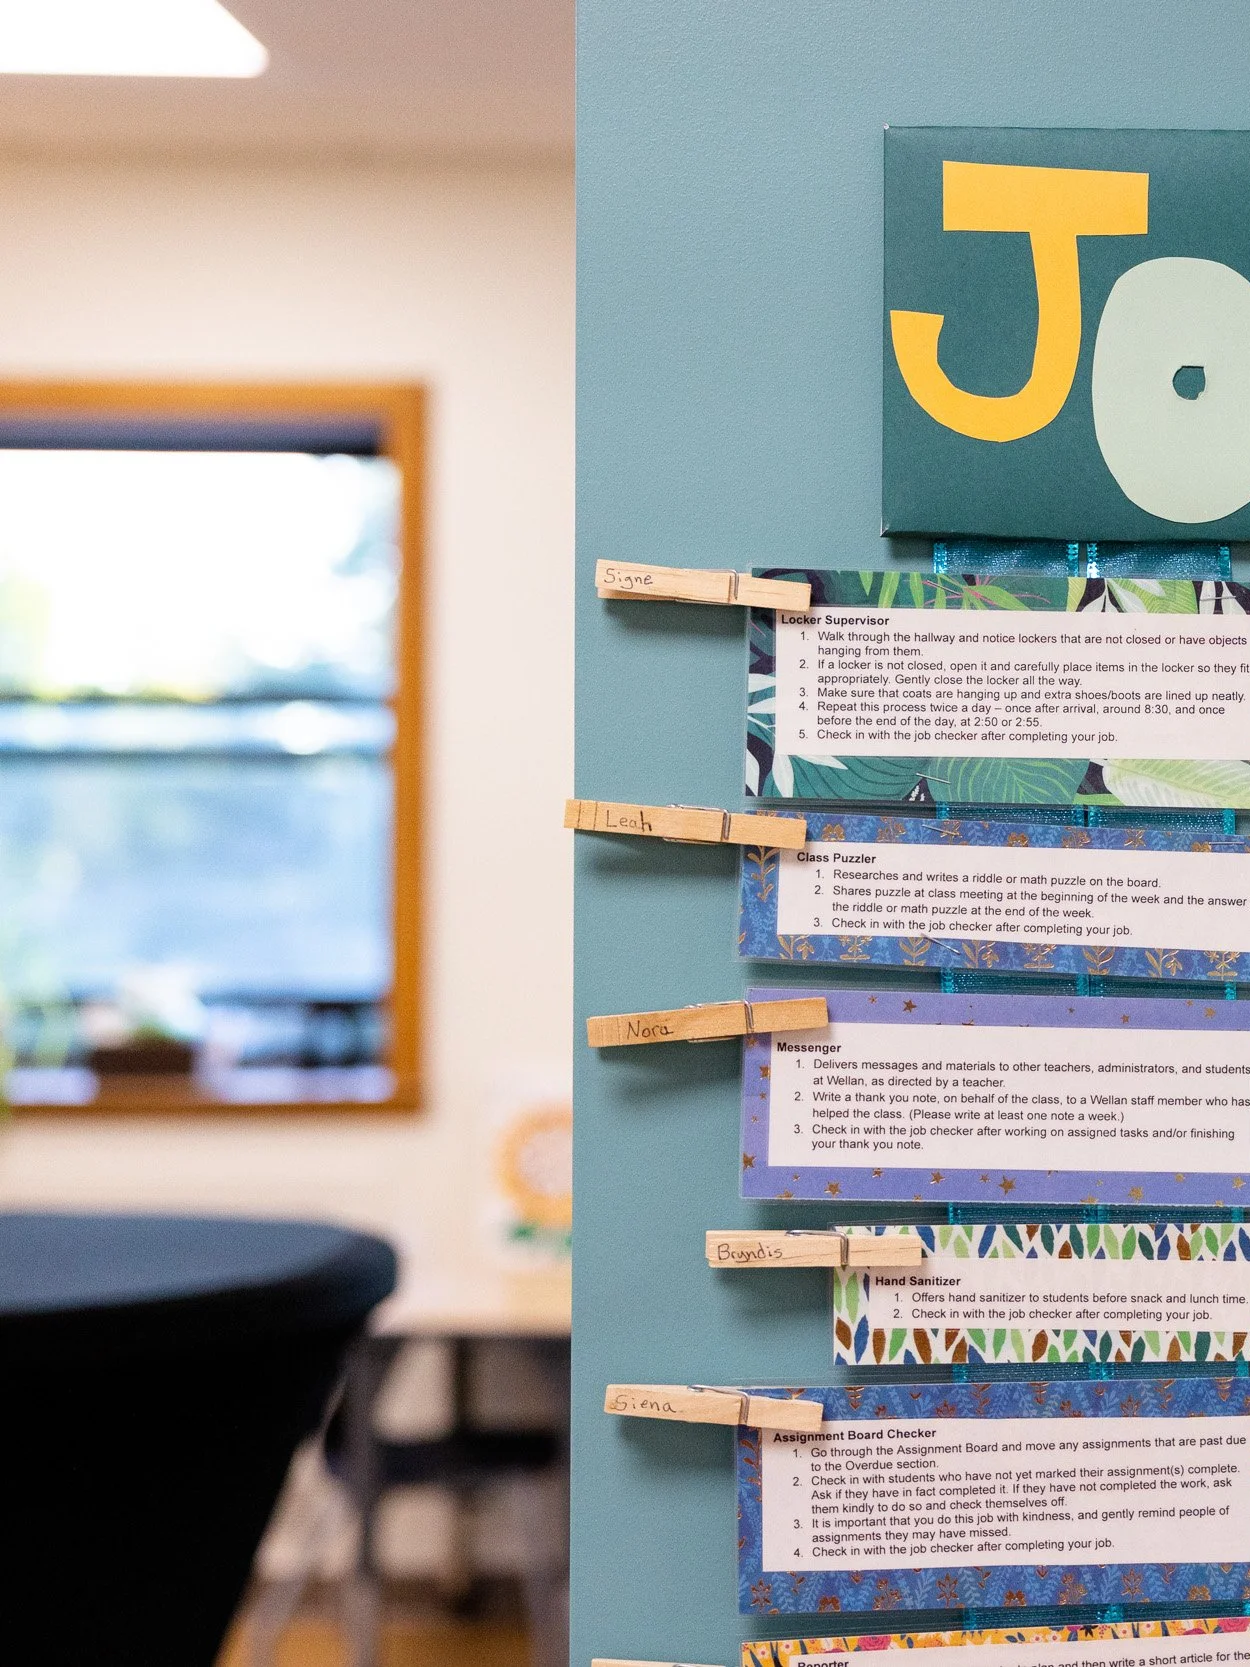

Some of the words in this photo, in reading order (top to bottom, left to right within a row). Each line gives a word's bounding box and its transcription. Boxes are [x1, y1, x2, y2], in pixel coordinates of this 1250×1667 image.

[604, 568, 653, 589] Signe
[781, 614, 822, 626] Locker
[824, 614, 890, 628] Supervisor
[800, 630, 809, 641] 1.
[817, 630, 845, 641] Walk
[846, 630, 890, 644] through
[892, 631, 911, 642] the
[913, 631, 956, 645] hallway
[958, 632, 979, 643] and
[982, 632, 1016, 643] notice
[1018, 632, 1058, 644] lockers
[1059, 633, 1081, 644] that
[1083, 635, 1102, 644] are
[1105, 634, 1123, 644] not
[1125, 633, 1161, 645] closed
[1164, 636, 1176, 645] or
[1178, 634, 1206, 645] have
[1207, 634, 1248, 648] objects
[606, 810, 652, 832] Leah
[797, 852, 829, 863] Class
[832, 851, 877, 864] Puzzler
[815, 868, 824, 878] 1.
[833, 868, 899, 881] Researches
[901, 870, 923, 882] and
[925, 871, 959, 882] writes
[961, 874, 969, 883] a
[972, 872, 1003, 884] riddle
[1005, 875, 1018, 884] or
[1019, 874, 1047, 885] math
[1050, 875, 1086, 887] puzzle
[1088, 877, 1103, 886] on
[1105, 876, 1124, 887] the
[1126, 876, 1161, 888] board.
[627, 1020, 674, 1040] Nora
[777, 1042, 841, 1055] Messenger
[812, 1075, 823, 1085] at
[825, 1074, 867, 1087] Wellan,
[870, 1077, 885, 1086] as
[886, 1075, 932, 1087] directed
[934, 1076, 949, 1090] by
[951, 1078, 959, 1087] a
[961, 1076, 1005, 1088] teacher.
[717, 1242, 783, 1263] Bryndis
[875, 1276, 905, 1286] Hand
[909, 1276, 961, 1286] Sanitizer
[893, 1291, 903, 1302] 1.
[911, 1291, 945, 1303] Offers
[947, 1291, 976, 1303] hand
[978, 1291, 1026, 1303] sanitizer
[1028, 1292, 1040, 1303] to
[1041, 1291, 1089, 1303] students
[1091, 1292, 1127, 1303] before
[1129, 1292, 1163, 1304] snack
[1164, 1292, 1186, 1304] and
[1189, 1292, 1219, 1304] lunch
[1221, 1292, 1248, 1304] time.
[611, 1394, 677, 1413] Siena
[773, 1431, 844, 1445] Assignment
[847, 1428, 884, 1440] Board
[886, 1427, 937, 1439] Checker
[810, 1461, 821, 1472] to
[823, 1460, 842, 1472] the
[844, 1459, 893, 1471] Overdue
[895, 1457, 939, 1469] section.
[1082, 1659, 1106, 1667] then
[1109, 1657, 1135, 1667] write
[1138, 1658, 1146, 1667] a
[1148, 1655, 1177, 1666] short
[1180, 1653, 1213, 1664] article
[1216, 1651, 1231, 1662] for
[1234, 1650, 1250, 1661] the
